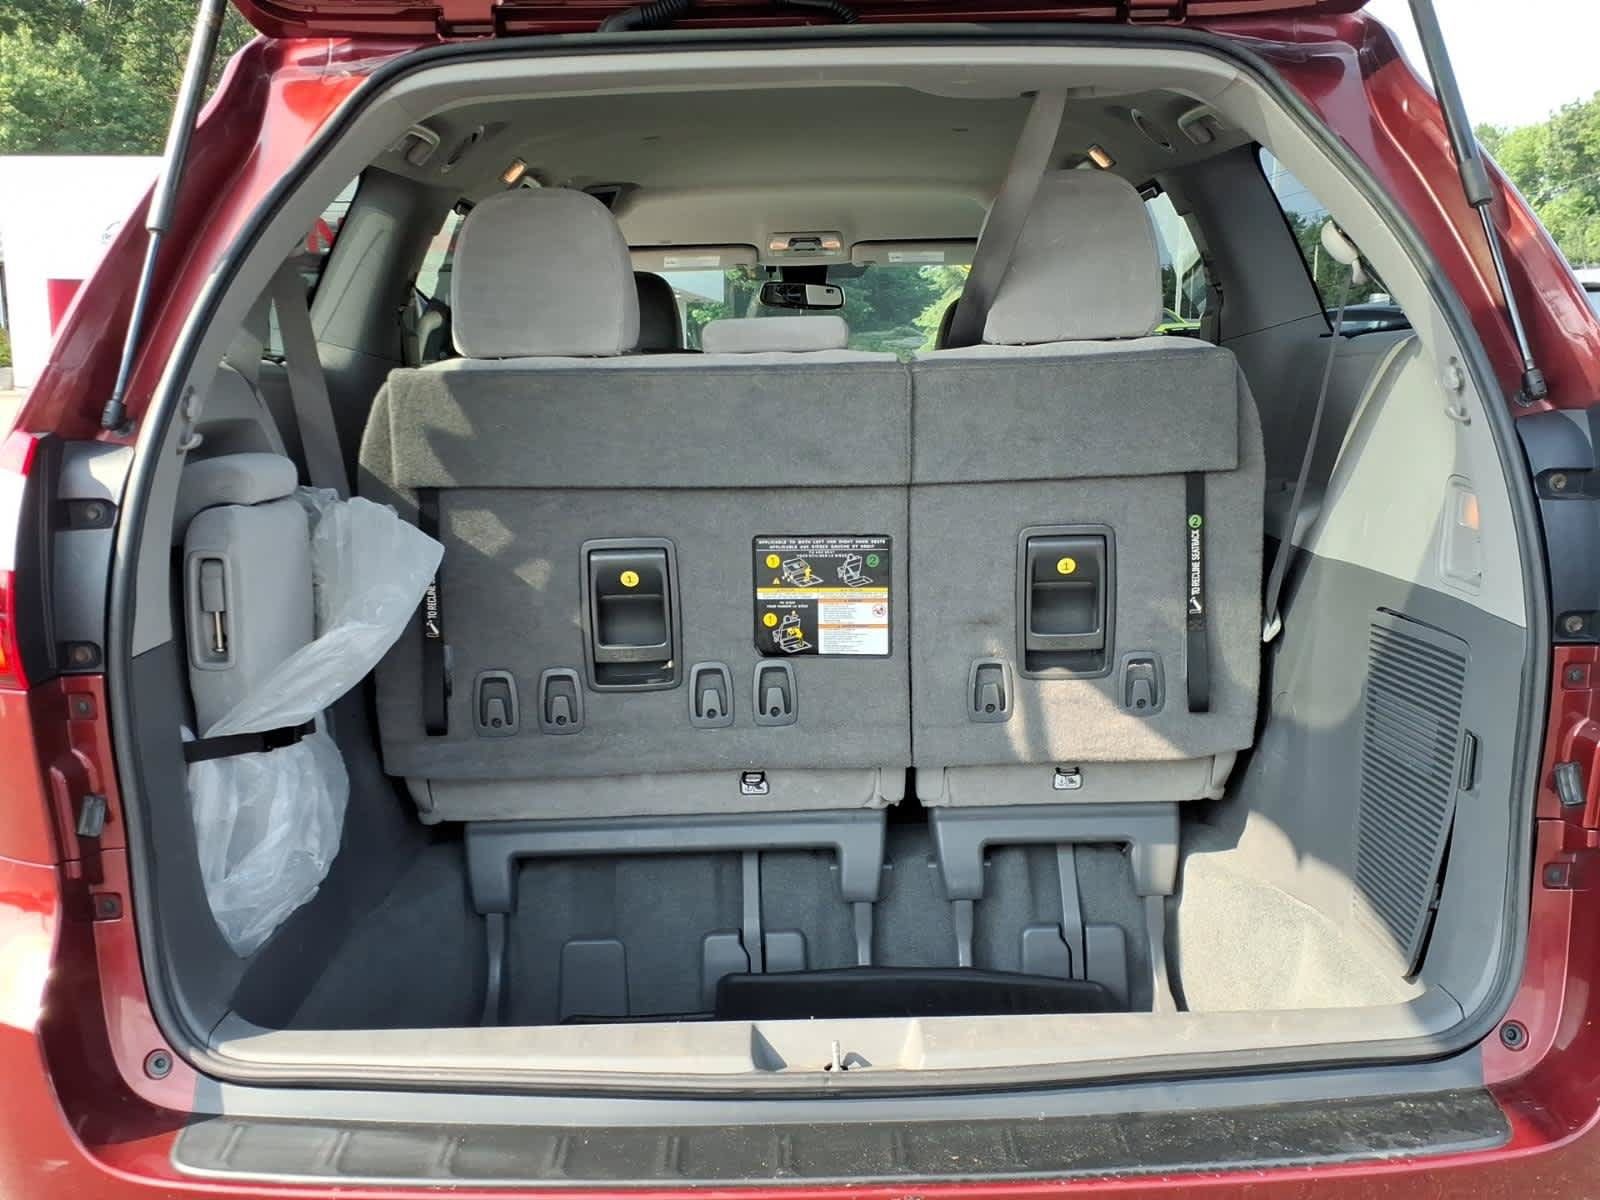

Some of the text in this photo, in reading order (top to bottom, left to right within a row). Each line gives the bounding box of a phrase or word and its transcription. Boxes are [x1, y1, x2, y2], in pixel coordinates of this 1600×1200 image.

[1191, 517, 1200, 527] 2
[1191, 529, 1200, 596] TO RECLINE SEATBACK
